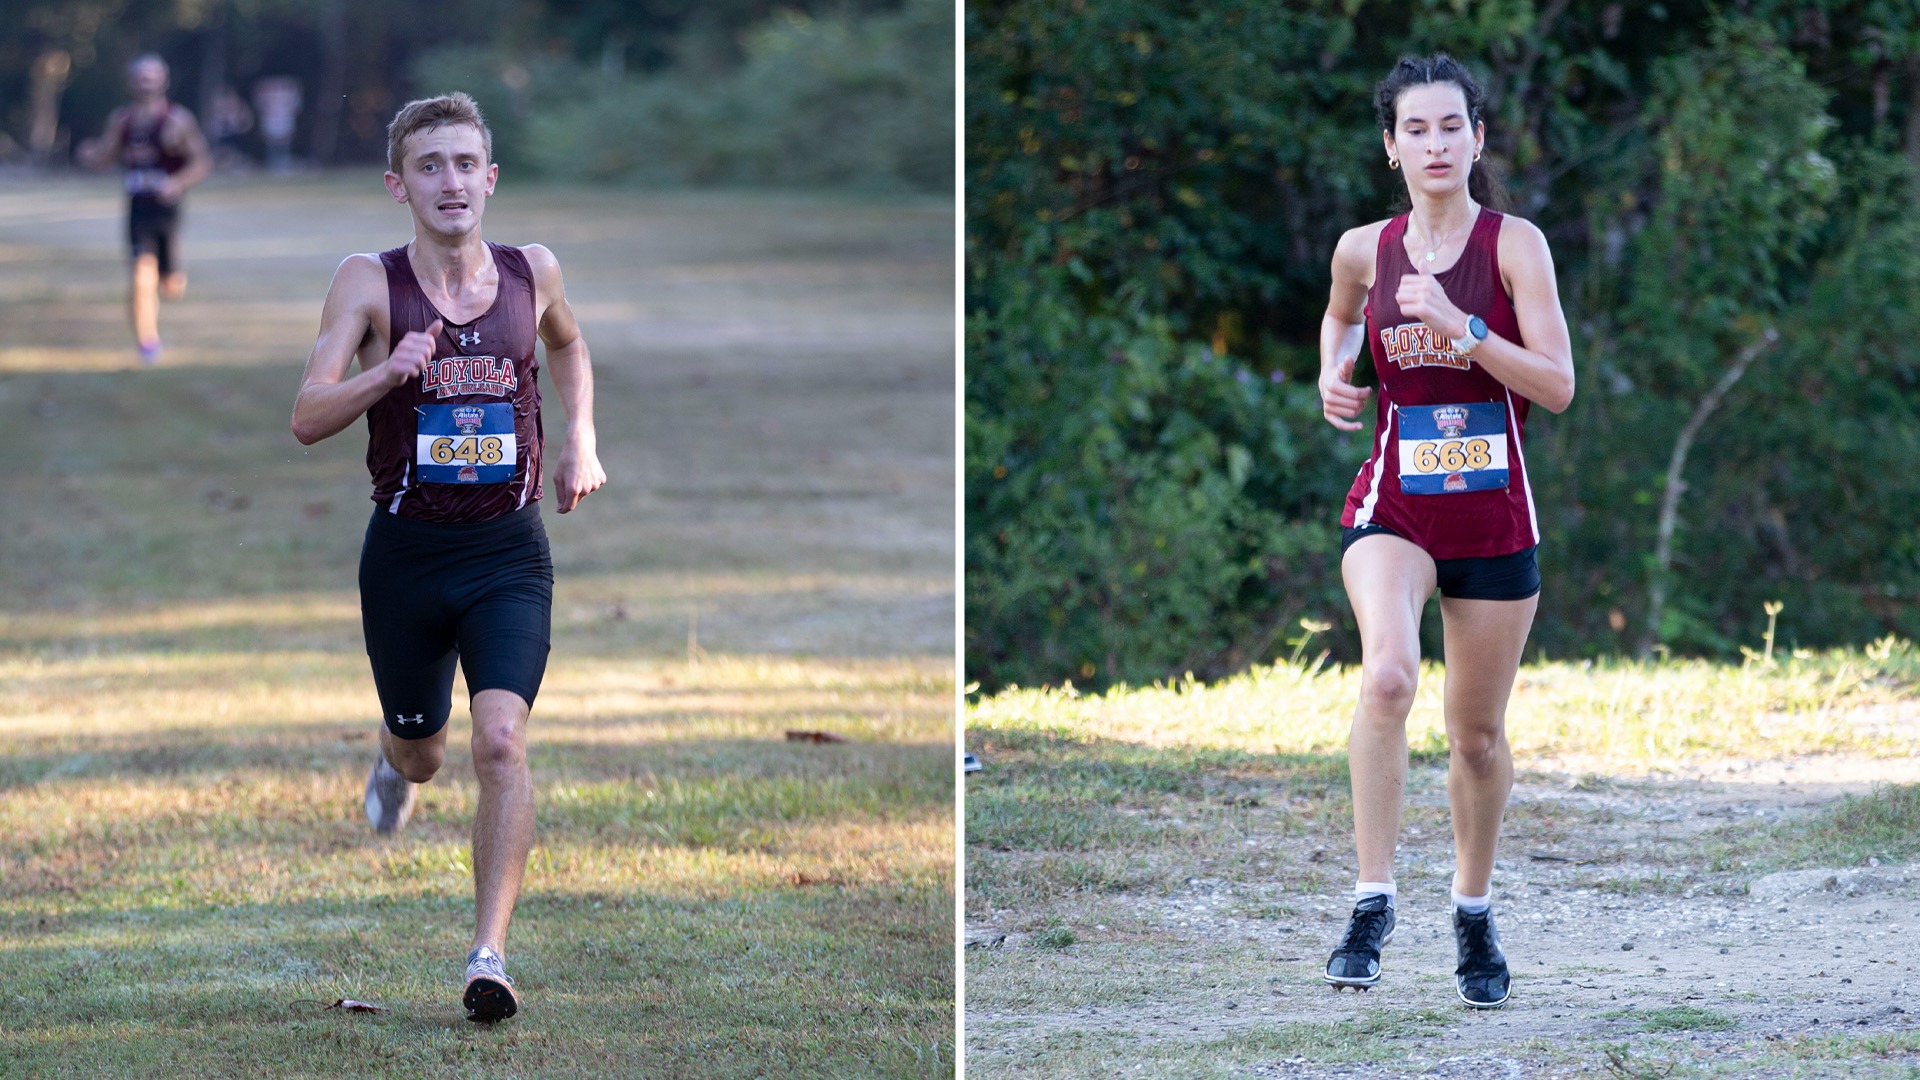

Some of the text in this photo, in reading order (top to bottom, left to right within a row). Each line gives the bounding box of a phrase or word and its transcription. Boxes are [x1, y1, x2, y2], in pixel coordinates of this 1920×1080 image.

[1381, 323, 1473, 361] LOYO
[423, 356, 517, 392] LOYOLA
[430, 437, 503, 465] 648
[1414, 439, 1492, 473] 668
